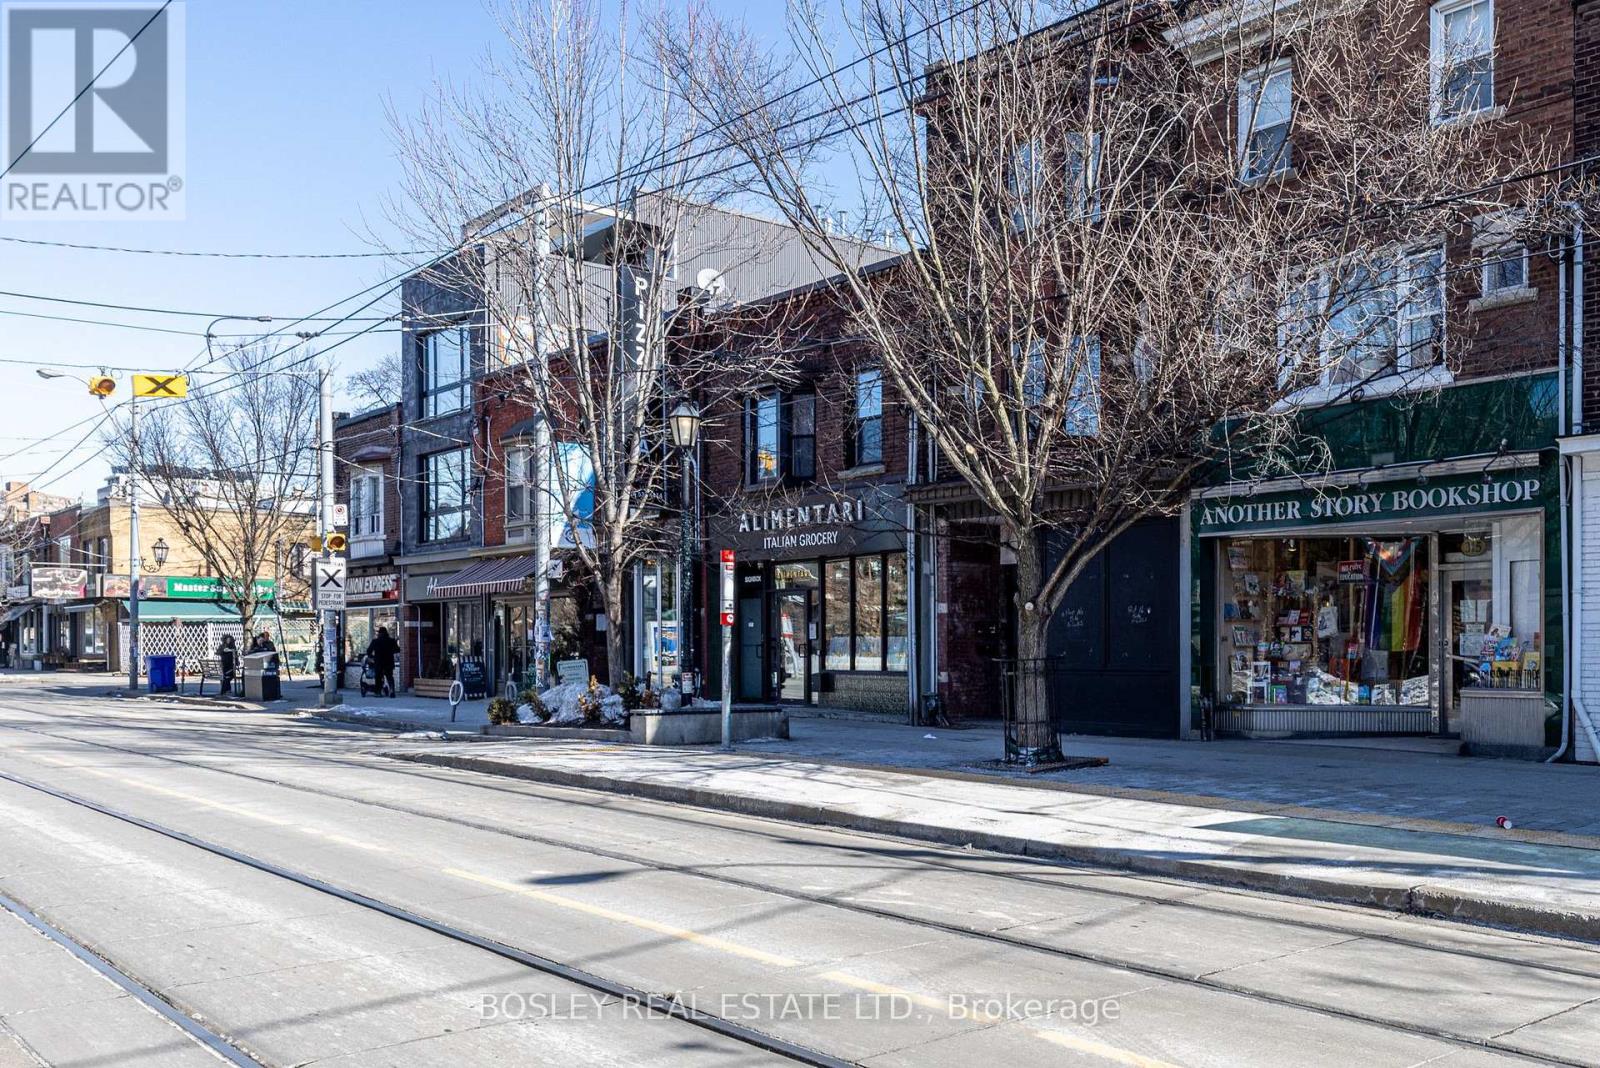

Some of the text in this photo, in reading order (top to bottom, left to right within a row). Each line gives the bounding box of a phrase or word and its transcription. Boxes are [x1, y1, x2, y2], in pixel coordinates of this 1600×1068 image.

[1200, 479, 1541, 526] ANOTHER STORY BOOKSHOP
[739, 500, 863, 532] ALIMENTARI
[764, 531, 838, 549] ITALIAN GROCERY
[173, 583, 208, 592] Master
[364, 573, 395, 592] EXPRESS
